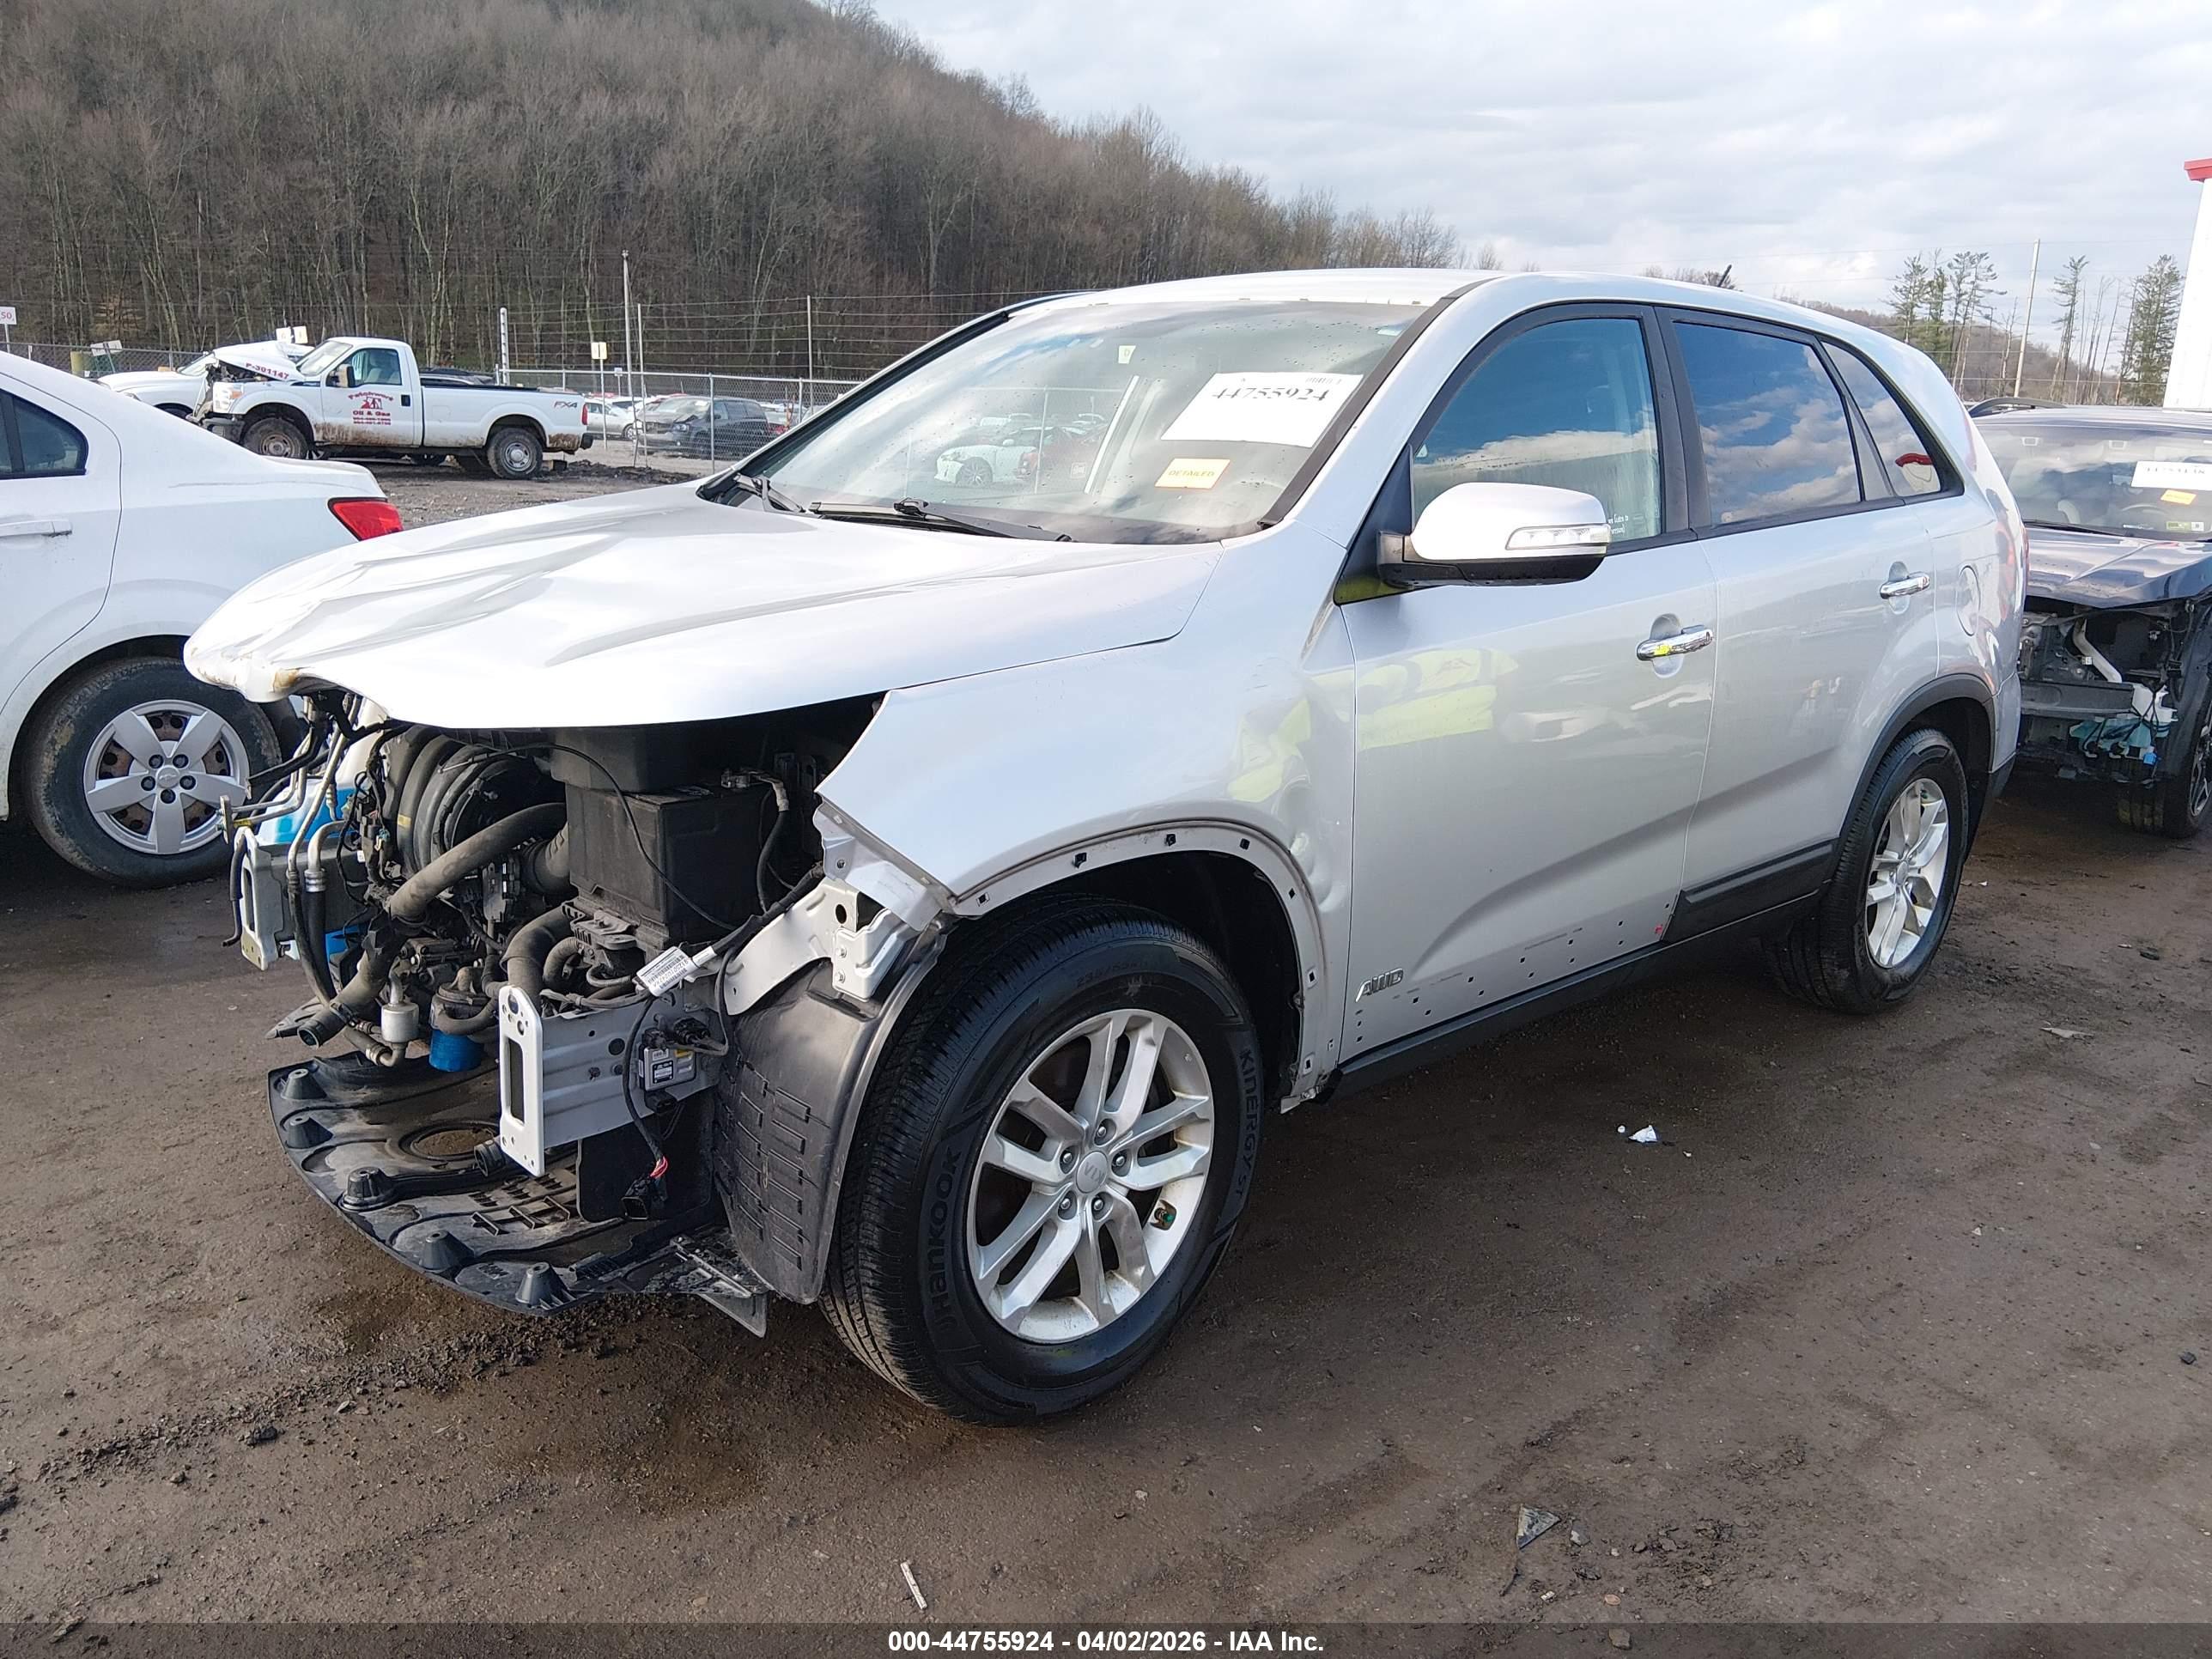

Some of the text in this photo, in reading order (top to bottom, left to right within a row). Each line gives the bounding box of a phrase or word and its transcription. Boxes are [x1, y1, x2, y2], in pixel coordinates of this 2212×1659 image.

[553, 400, 578, 409] FX4
[1212, 388, 1329, 401] 44755924
[1355, 968, 1404, 1003] AWD
[1239, 1048, 1260, 1171] KINERGY
[1084, 1161, 1105, 1182] KIA
[927, 1146, 963, 1328] Hankook
